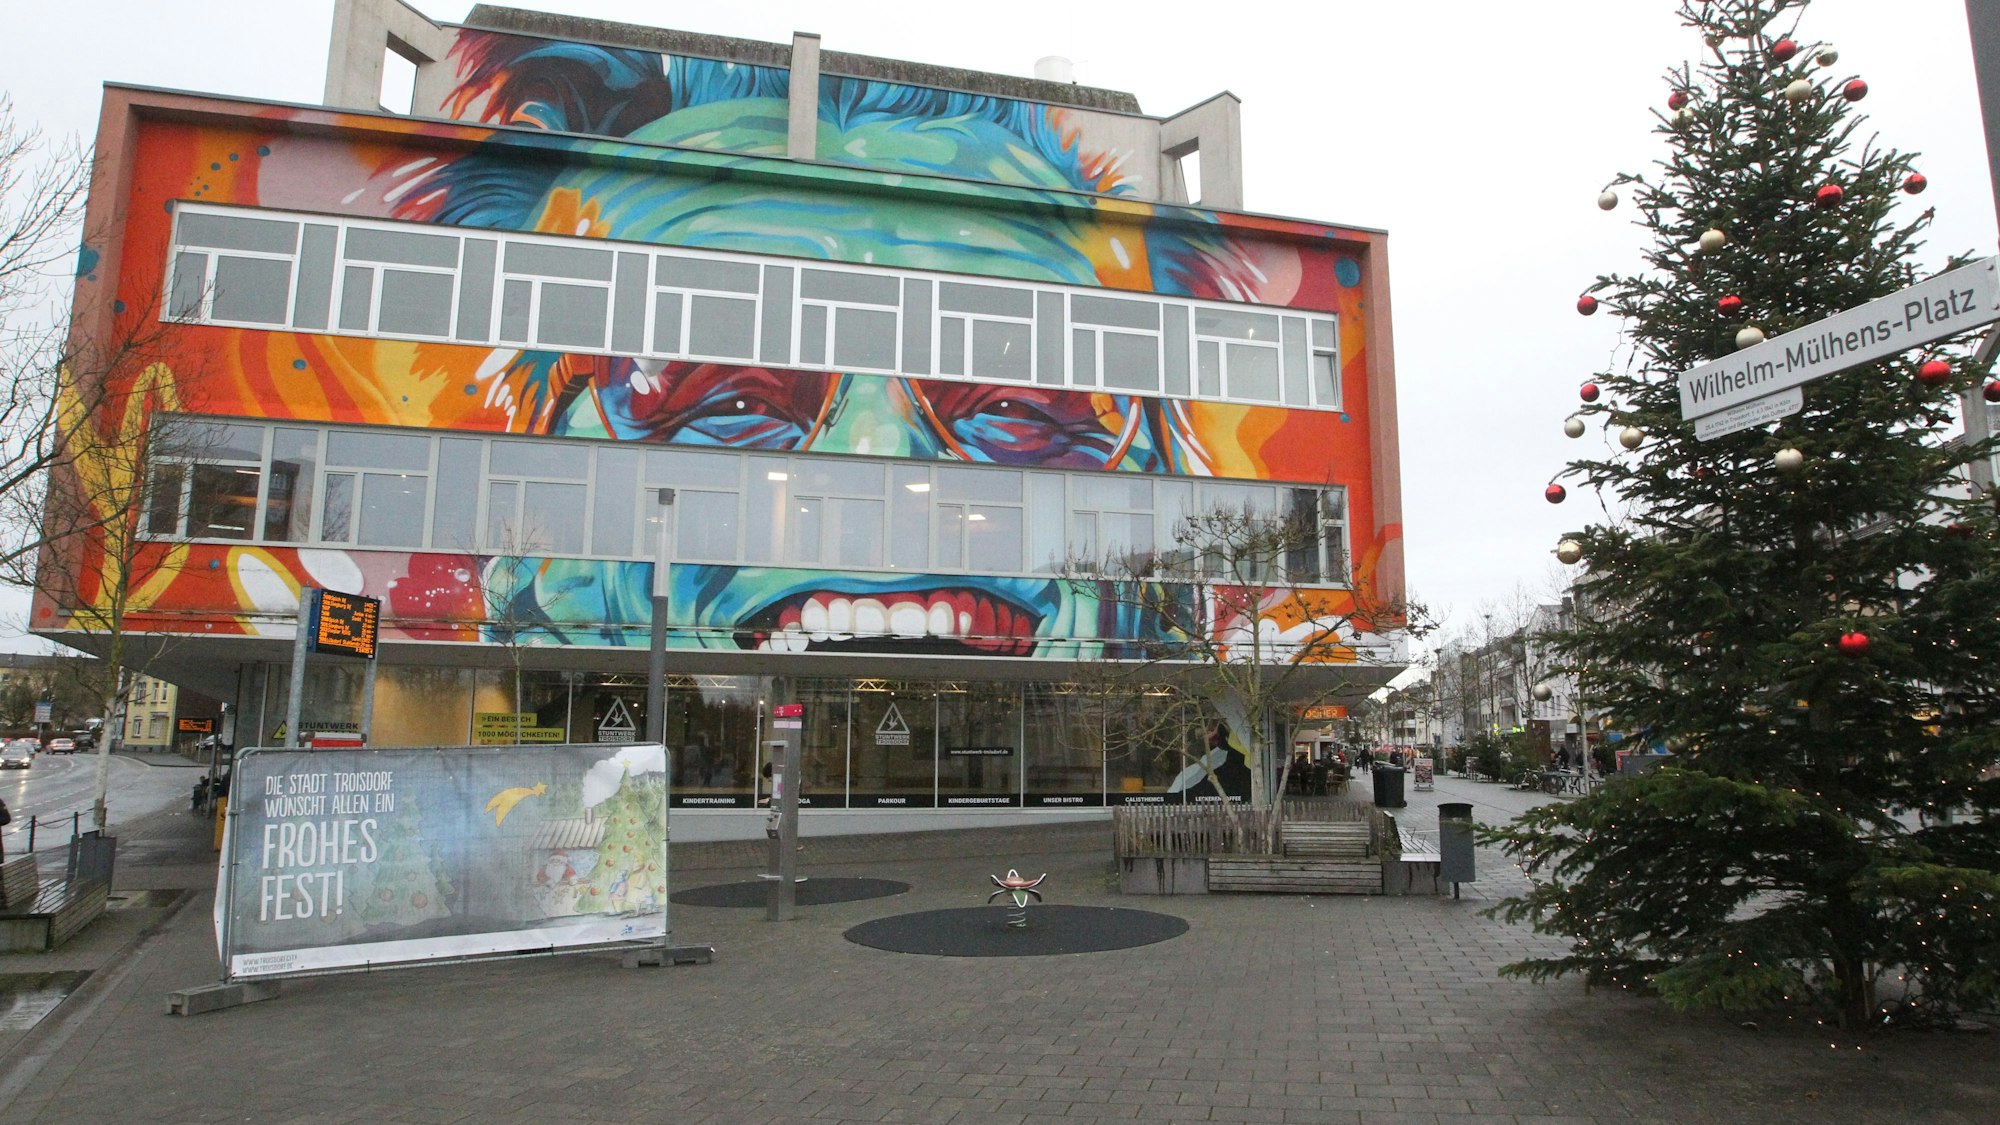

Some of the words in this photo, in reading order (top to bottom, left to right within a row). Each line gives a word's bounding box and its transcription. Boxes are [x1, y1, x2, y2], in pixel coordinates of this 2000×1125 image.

[1689, 288, 1976, 403] Wilhelm-Mülhens-Platz
[1727, 406, 1745, 416] Wilhelm
[266, 776, 283, 795] DIE
[290, 773, 328, 794] STADT
[334, 771, 393, 792] TROISDORF
[265, 795, 326, 818] WÜNSCHT
[332, 794, 369, 814] ALLEN
[375, 793, 395, 813] EIN
[262, 818, 378, 869] FROHES
[260, 870, 344, 921] FEST!
